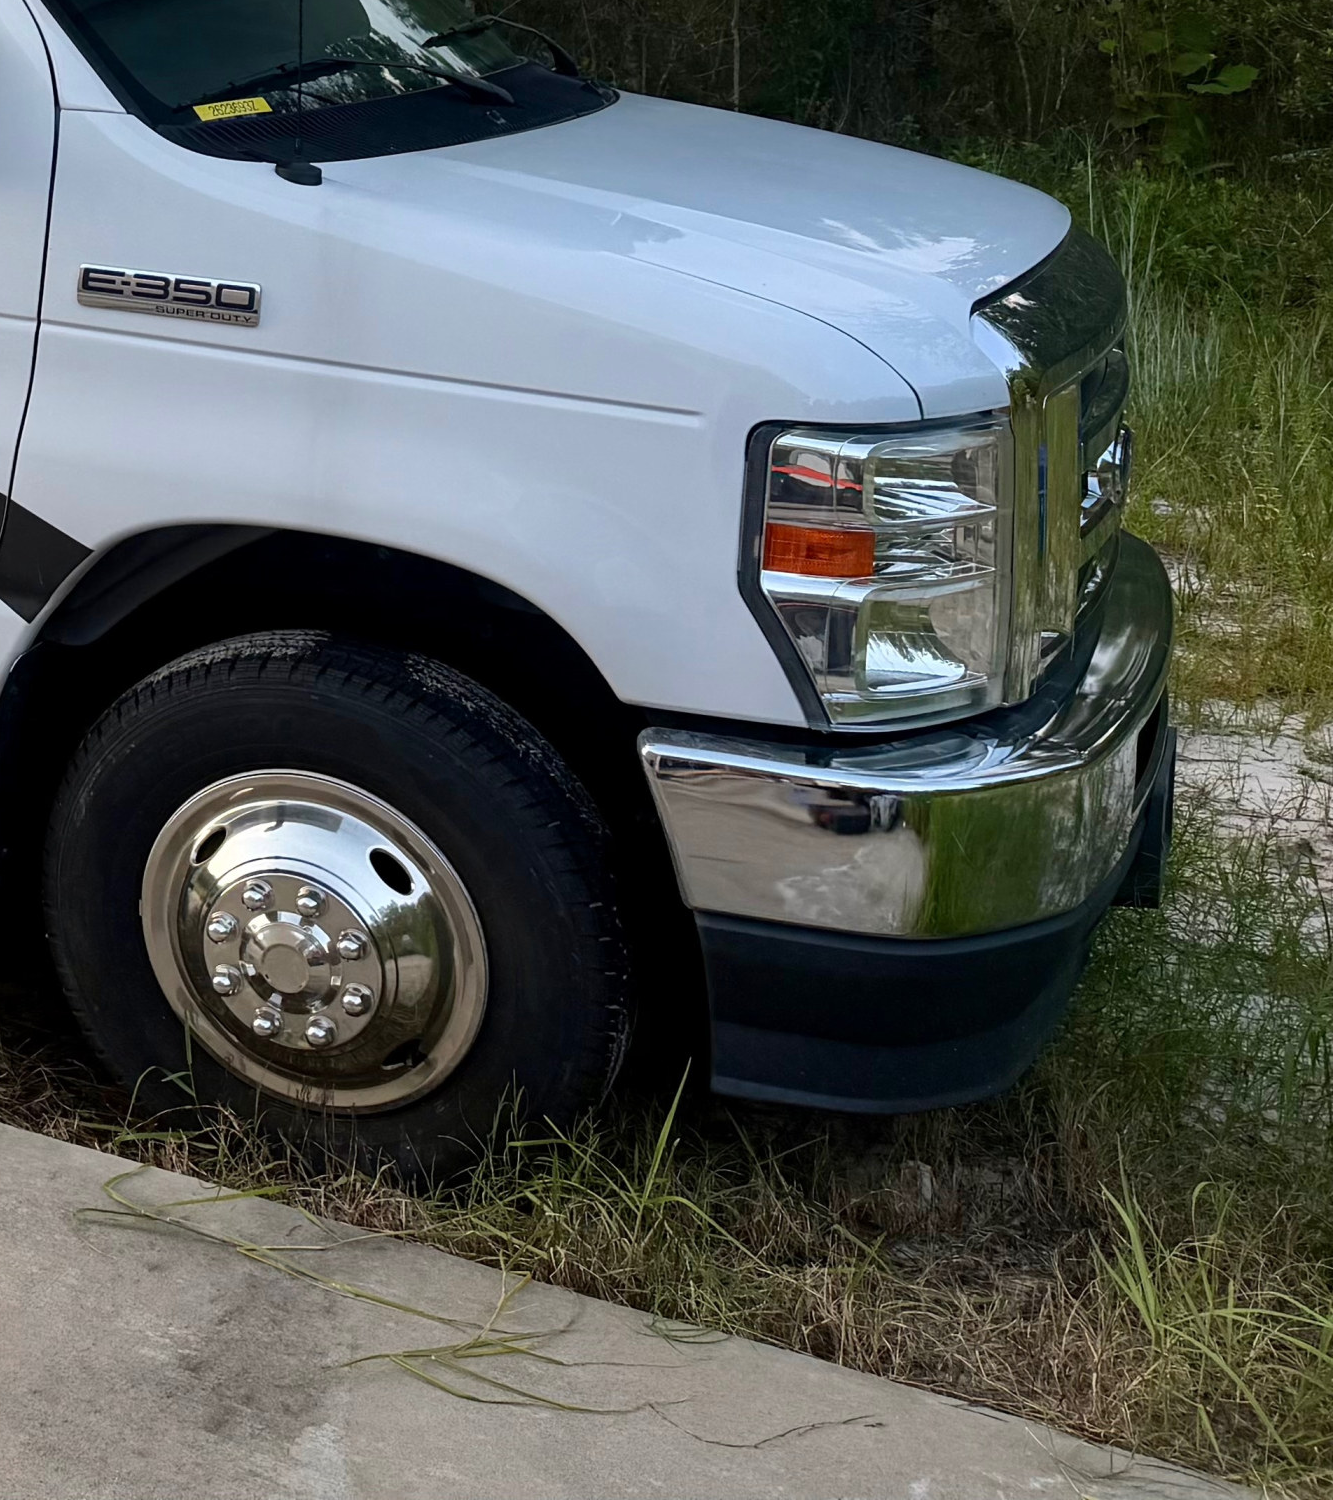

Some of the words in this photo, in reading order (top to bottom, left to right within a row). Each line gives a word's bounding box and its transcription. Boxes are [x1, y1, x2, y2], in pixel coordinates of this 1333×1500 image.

[81, 266, 257, 311] E-350
[154, 305, 206, 319] SUPER
[209, 311, 253, 324] DUTY
